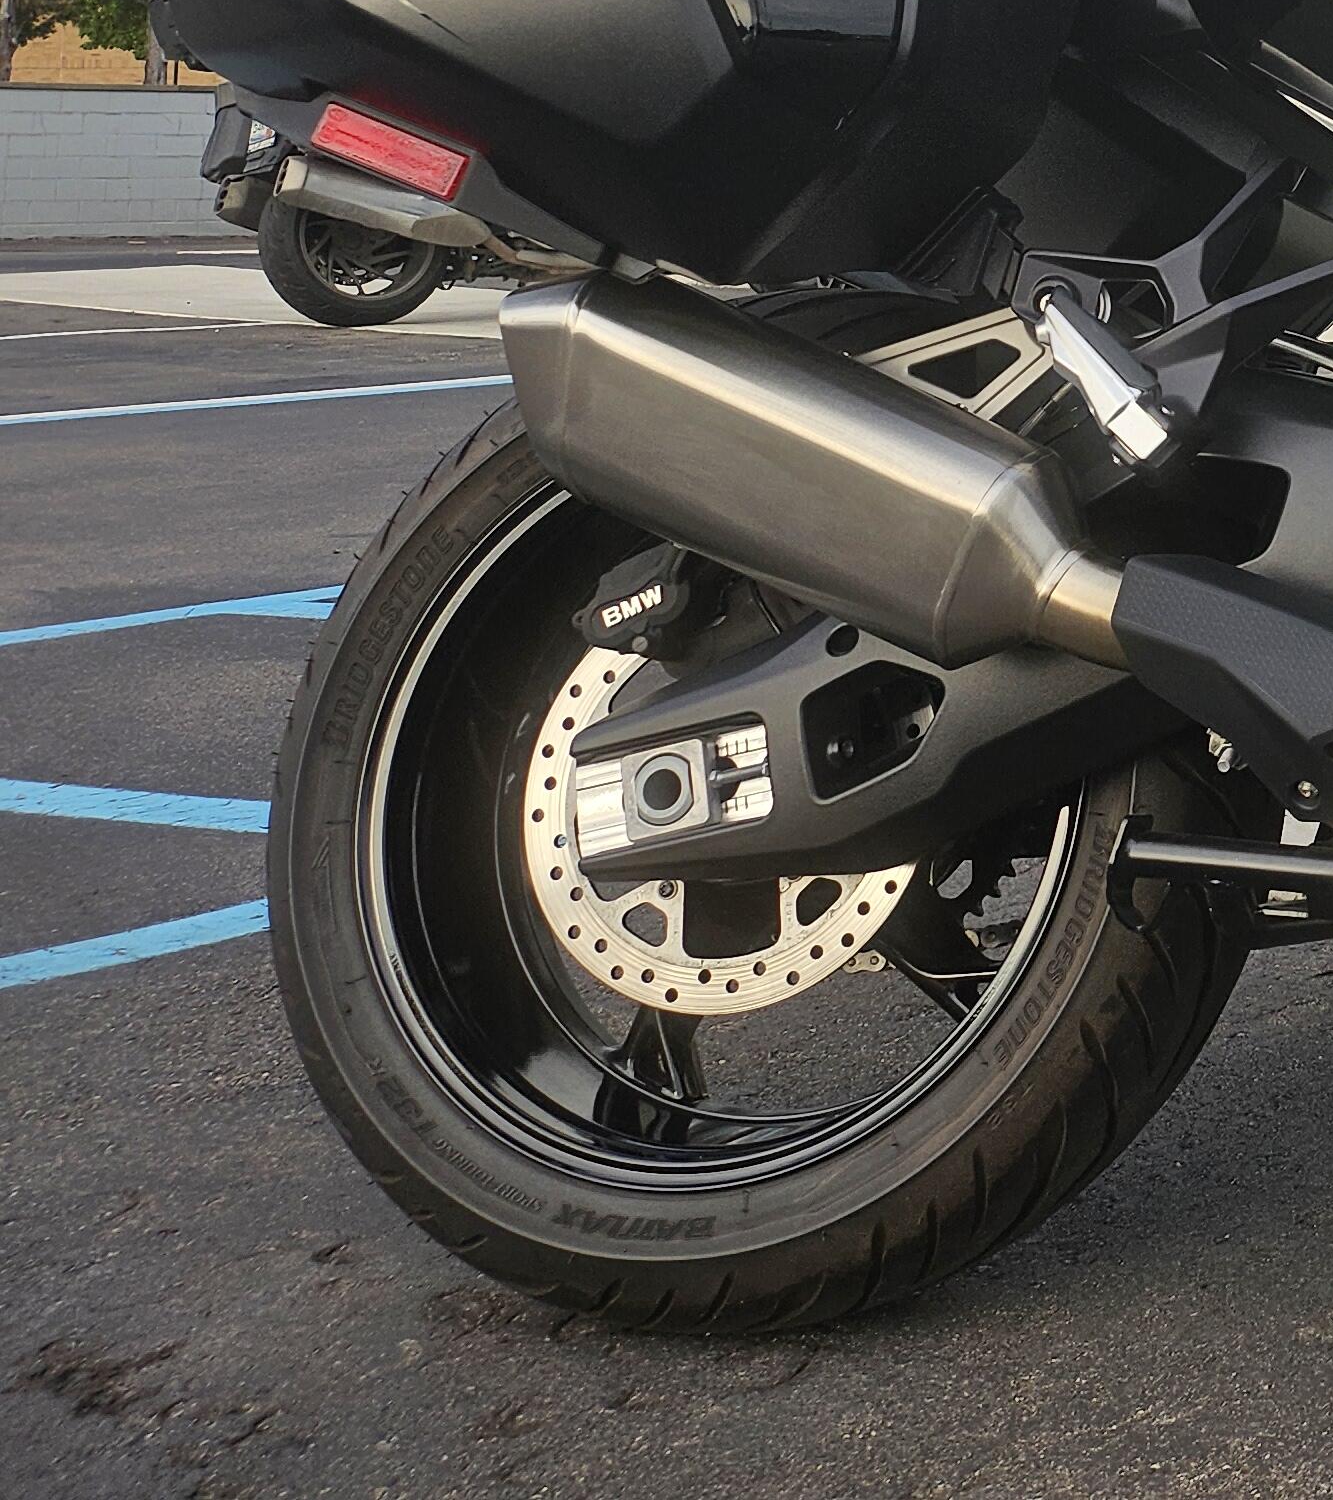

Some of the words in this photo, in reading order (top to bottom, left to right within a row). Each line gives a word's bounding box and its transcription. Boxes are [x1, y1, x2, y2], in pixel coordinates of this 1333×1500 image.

[601, 584, 662, 628] BMW
[321, 525, 456, 750] BRIDGESTONE
[431, 1138, 495, 1192] TOURING
